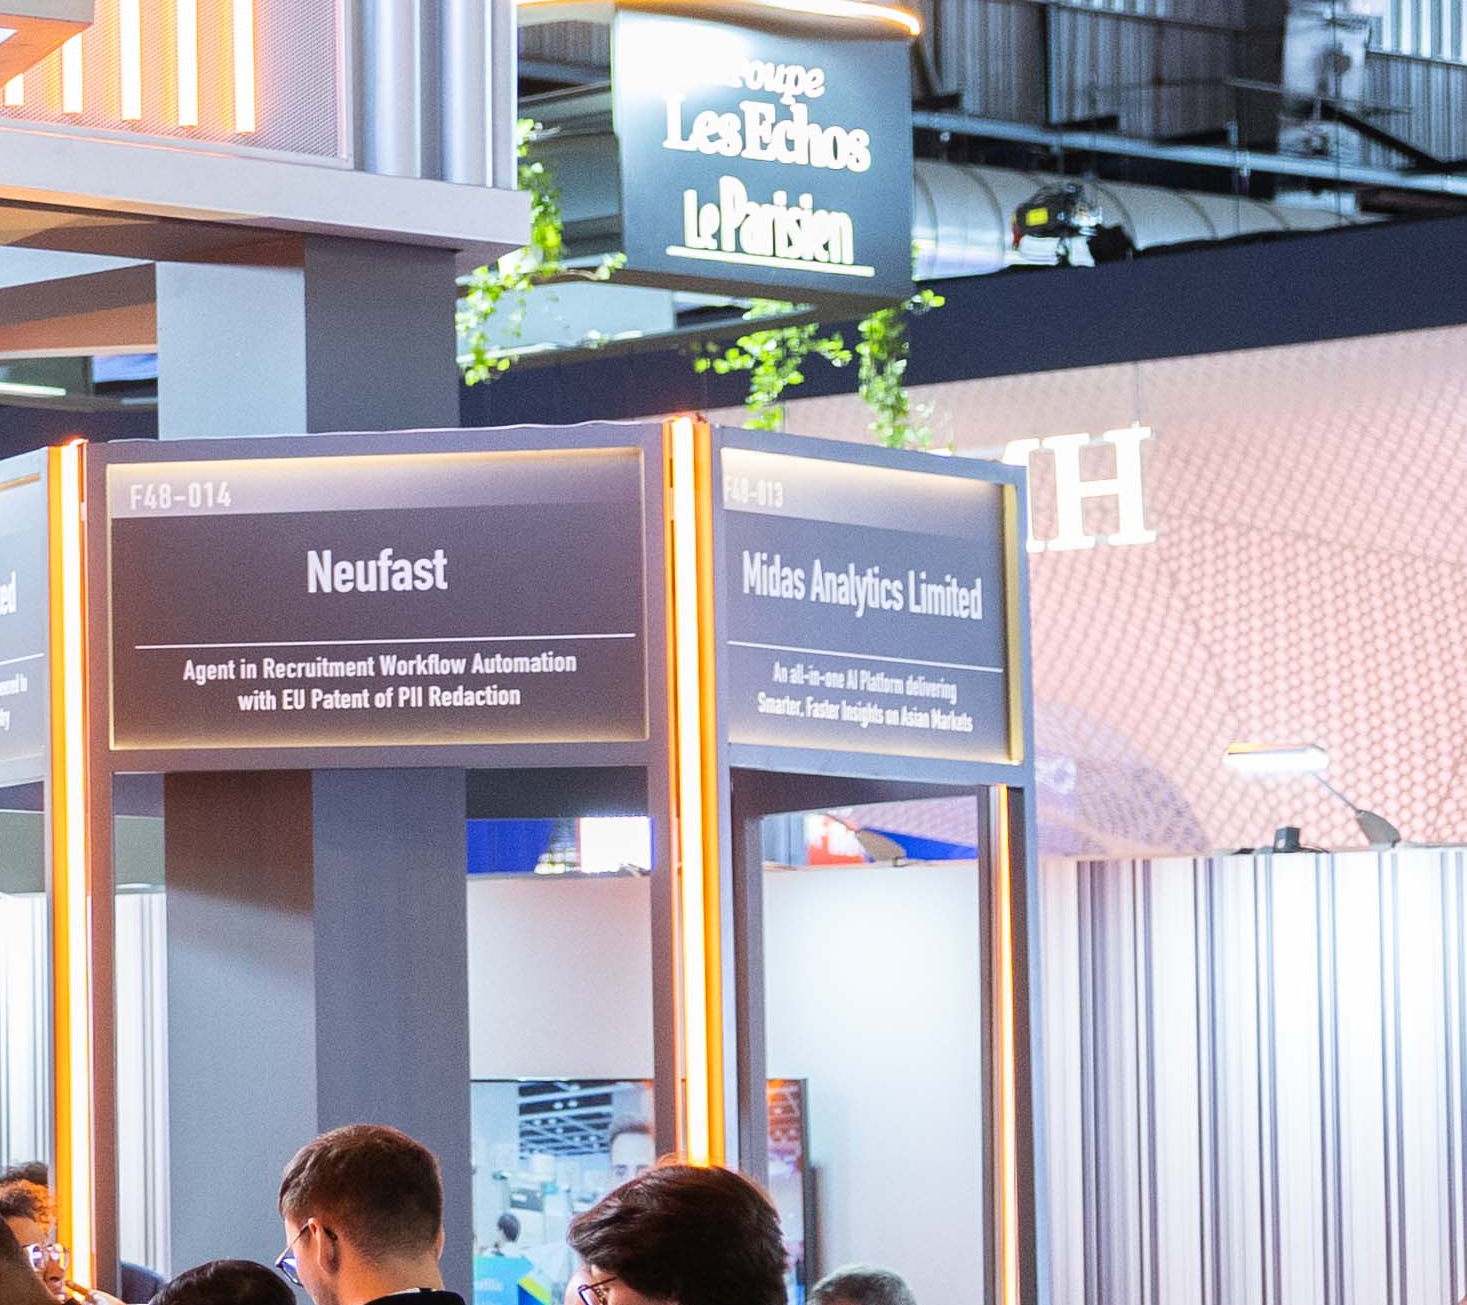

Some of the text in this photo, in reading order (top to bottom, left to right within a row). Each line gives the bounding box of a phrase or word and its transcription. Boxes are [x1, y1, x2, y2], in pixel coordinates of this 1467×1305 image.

[739, 100, 871, 173] Echos
[719, 175, 854, 265] Parisien
[130, 481, 231, 511] F48-014
[307, 548, 448, 593] Neufast
[743, 550, 983, 620] Midas Analytics Limited
[183, 652, 576, 685] Agent in Recruitment Workflow Automation
[238, 690, 277, 711] with
[282, 689, 305, 710] EU
[311, 688, 370, 709] Patent
[374, 688, 393, 708] of
[428, 685, 521, 707] Redaction
[859, 670, 904, 694] Platform
[906, 675, 958, 705] delivering
[806, 696, 840, 720] Faster
[841, 700, 883, 728] Insights
[900, 706, 930, 729] Asian
[931, 708, 973, 733] Markets
